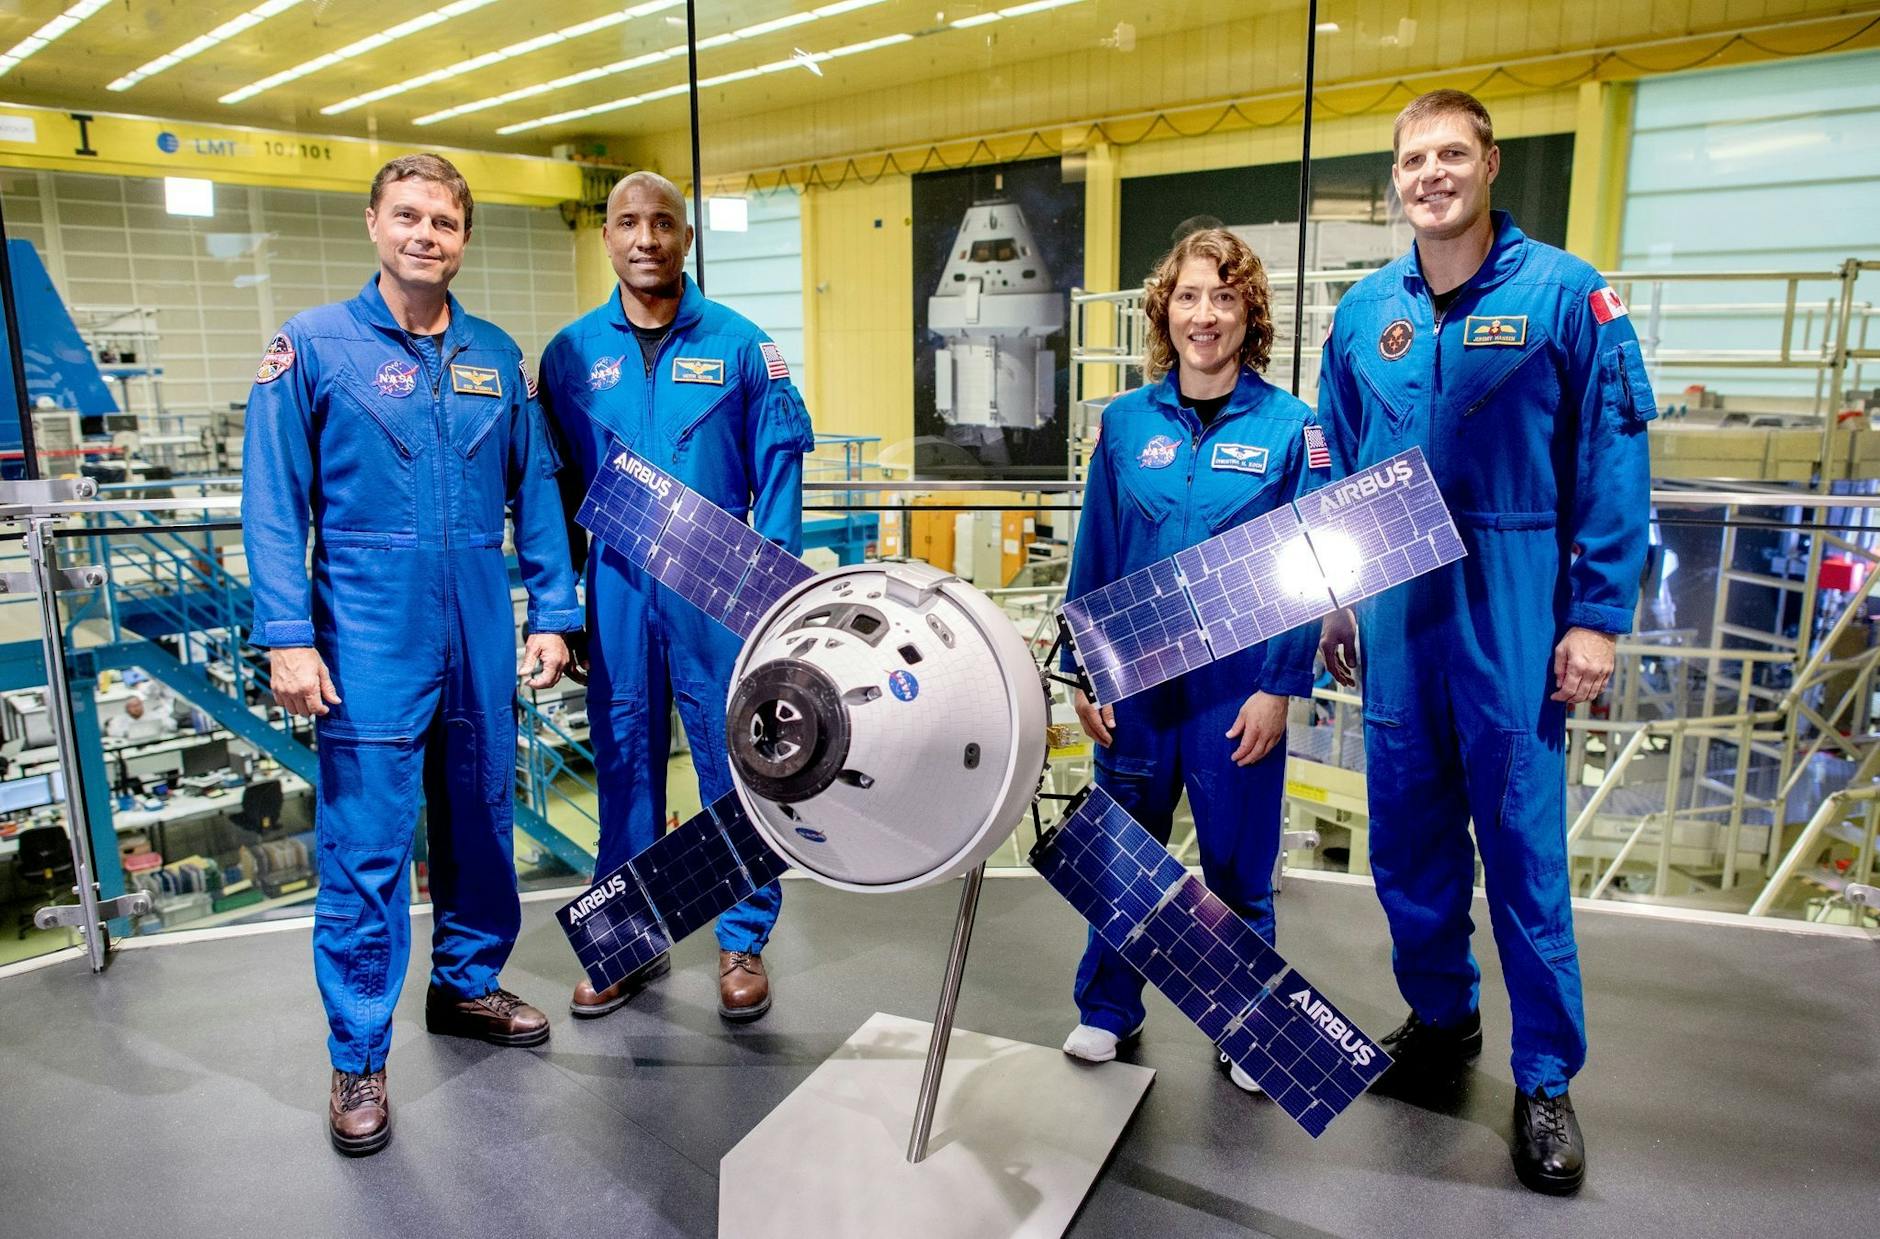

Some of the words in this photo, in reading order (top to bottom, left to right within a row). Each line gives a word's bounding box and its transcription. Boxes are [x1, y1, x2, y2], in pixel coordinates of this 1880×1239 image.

[194, 139, 236, 157] LMT
[379, 373, 415, 386] NASA
[613, 452, 672, 497] AIRBUS
[1143, 447, 1175, 460] NASA
[1320, 460, 1413, 516] AIRBUS
[569, 874, 626, 925] AIRBUS
[1289, 989, 1376, 1066] AIRBUS
